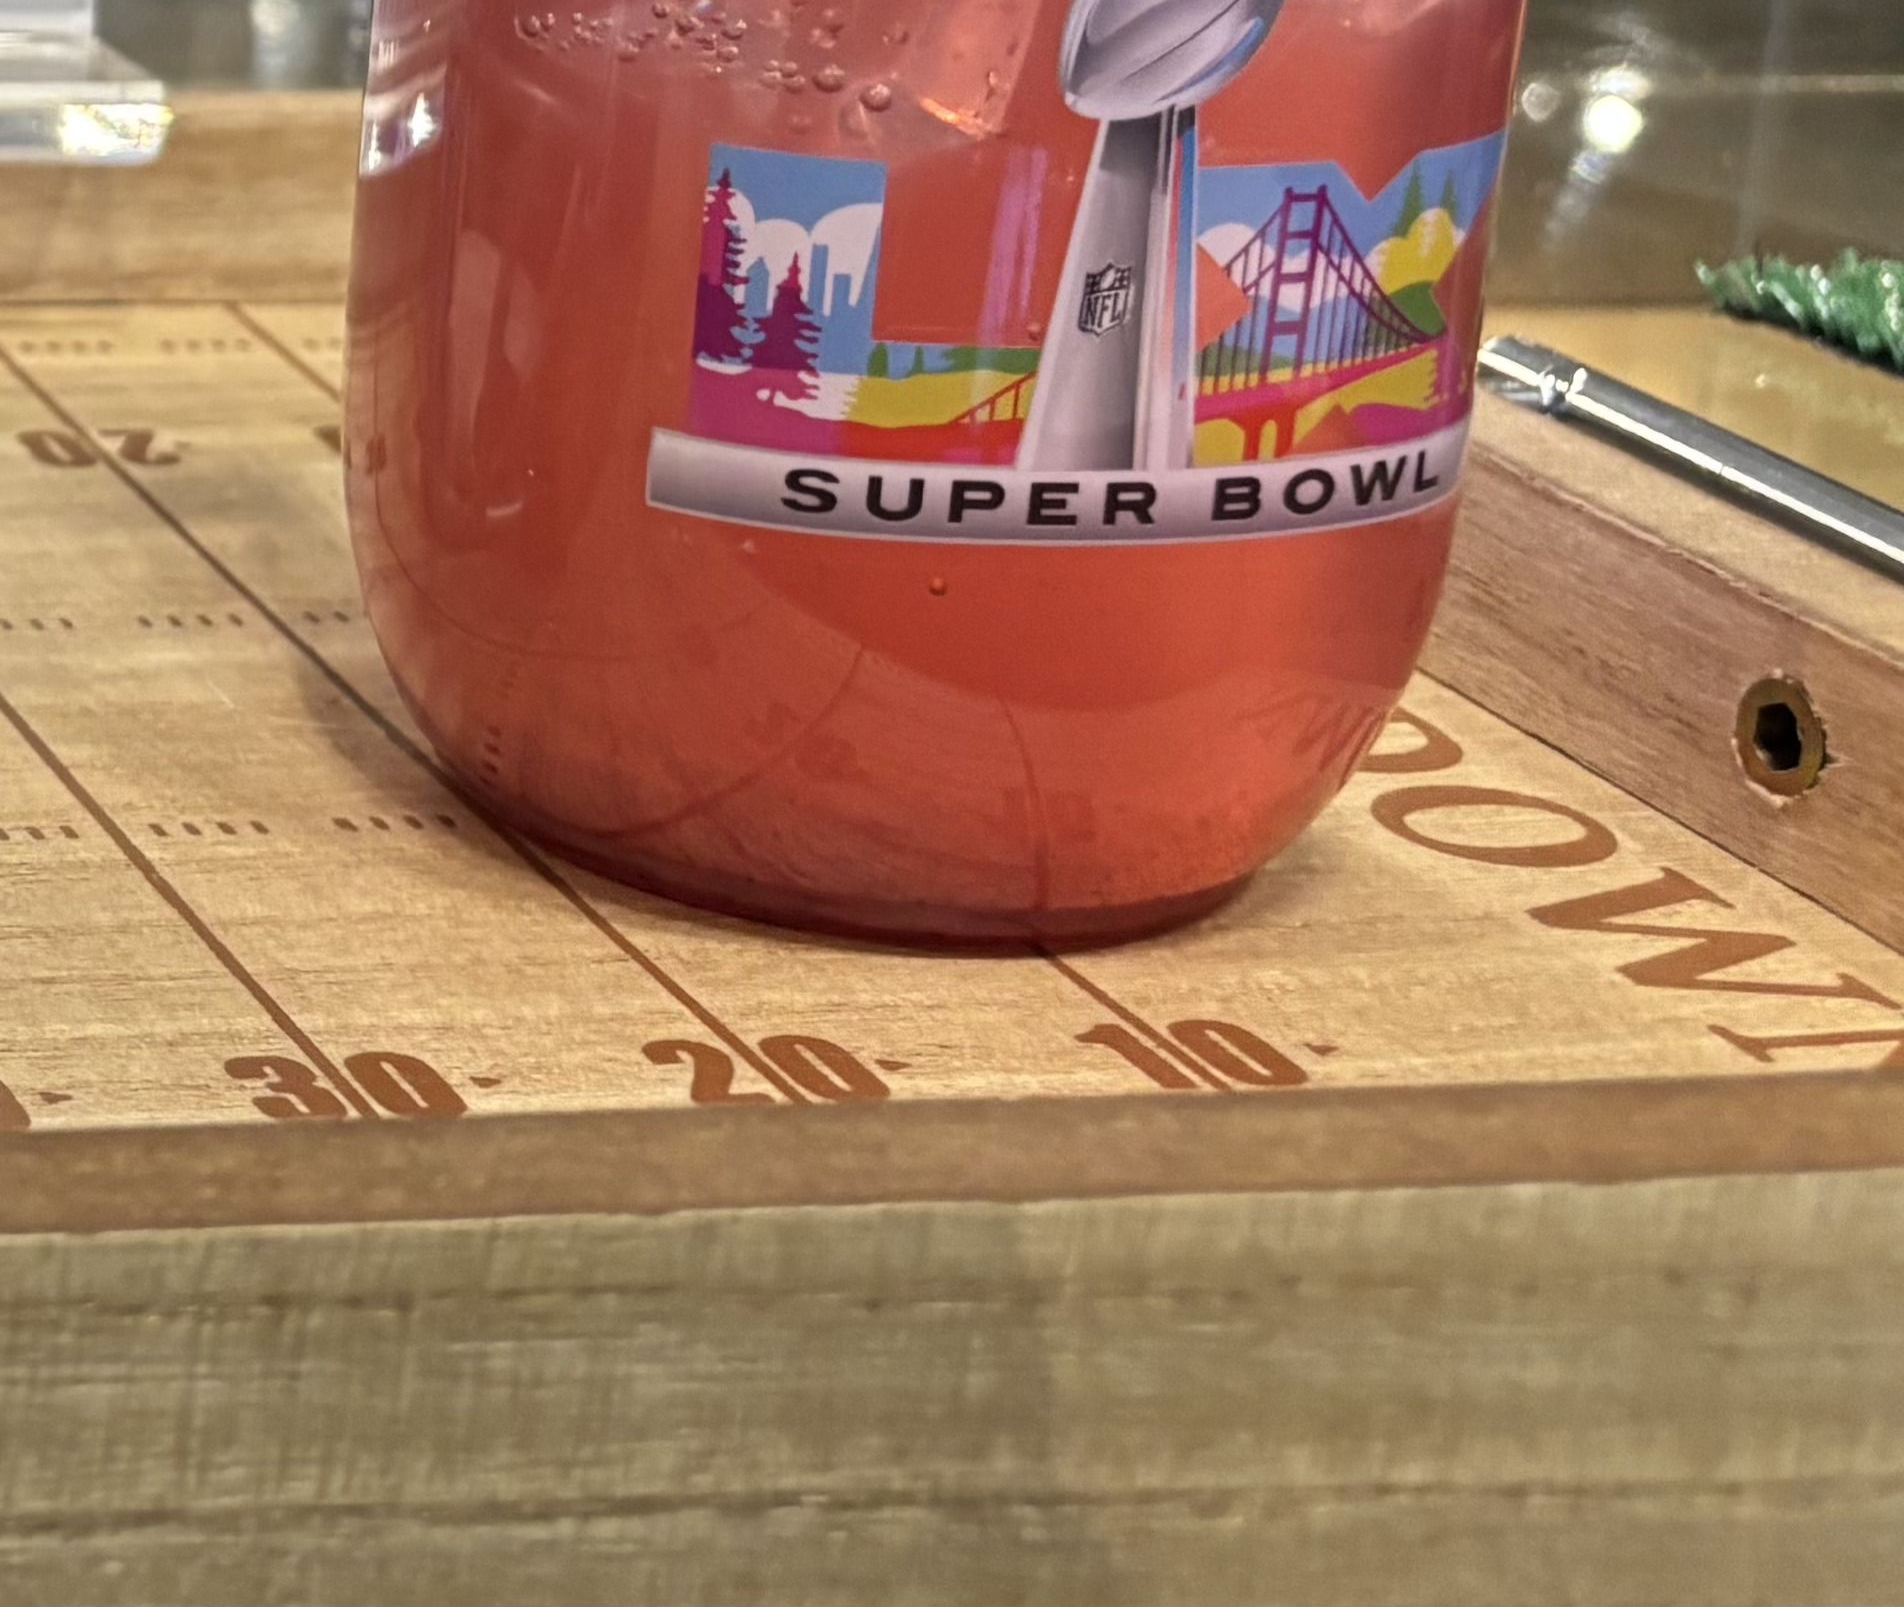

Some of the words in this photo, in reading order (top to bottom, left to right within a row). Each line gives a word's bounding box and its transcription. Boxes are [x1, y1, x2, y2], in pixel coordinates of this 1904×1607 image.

[780, 468, 1158, 526] SUPER
[1210, 458, 1441, 523] BOWL
[225, 1050, 467, 1118] 30
[642, 1034, 891, 1104] 20
[1076, 1018, 1309, 1089] 10
